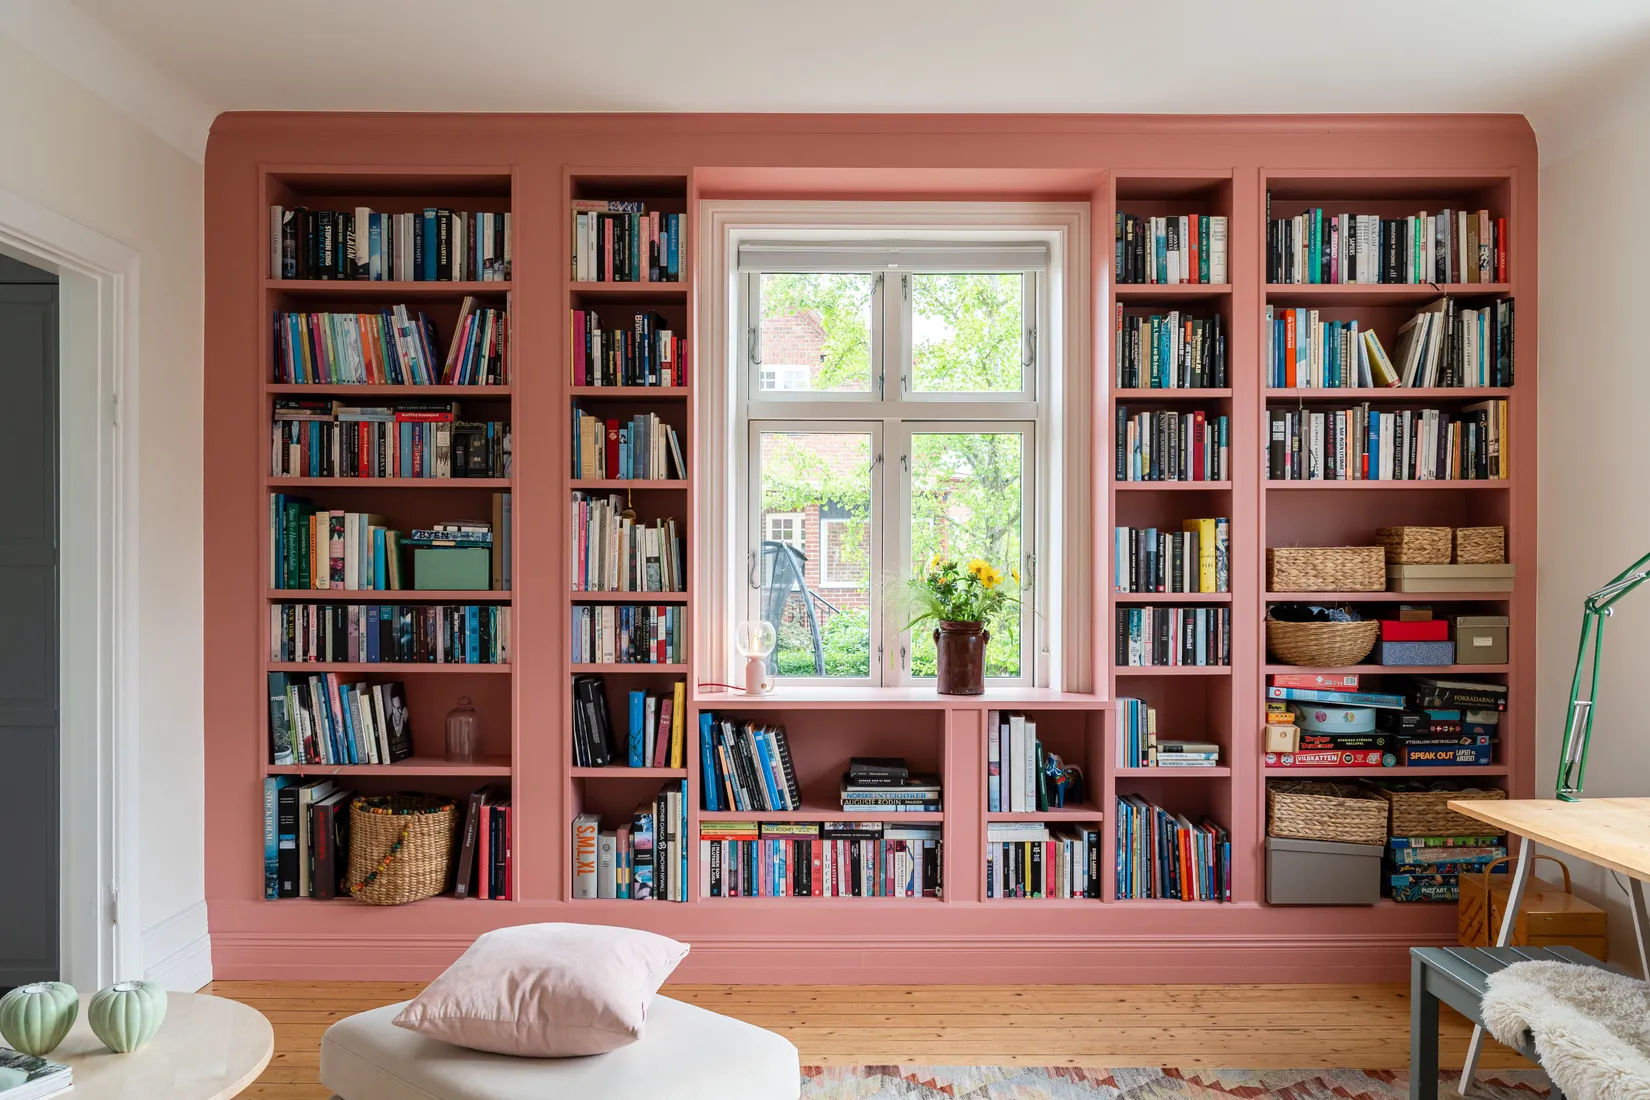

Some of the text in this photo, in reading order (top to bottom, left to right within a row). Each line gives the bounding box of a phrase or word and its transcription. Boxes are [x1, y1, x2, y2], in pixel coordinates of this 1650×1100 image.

[346, 231, 356, 259] ZLATAN
[1348, 237, 1356, 256] SAPIENS
[419, 531, 449, 540] BYEN
[1297, 754, 1337, 762] VILDKATTEN
[1409, 751, 1454, 760] SPEAK OUT
[265, 789, 274, 840] STOCKHOLM
[576, 825, 596, 877] S,M,L,XL
